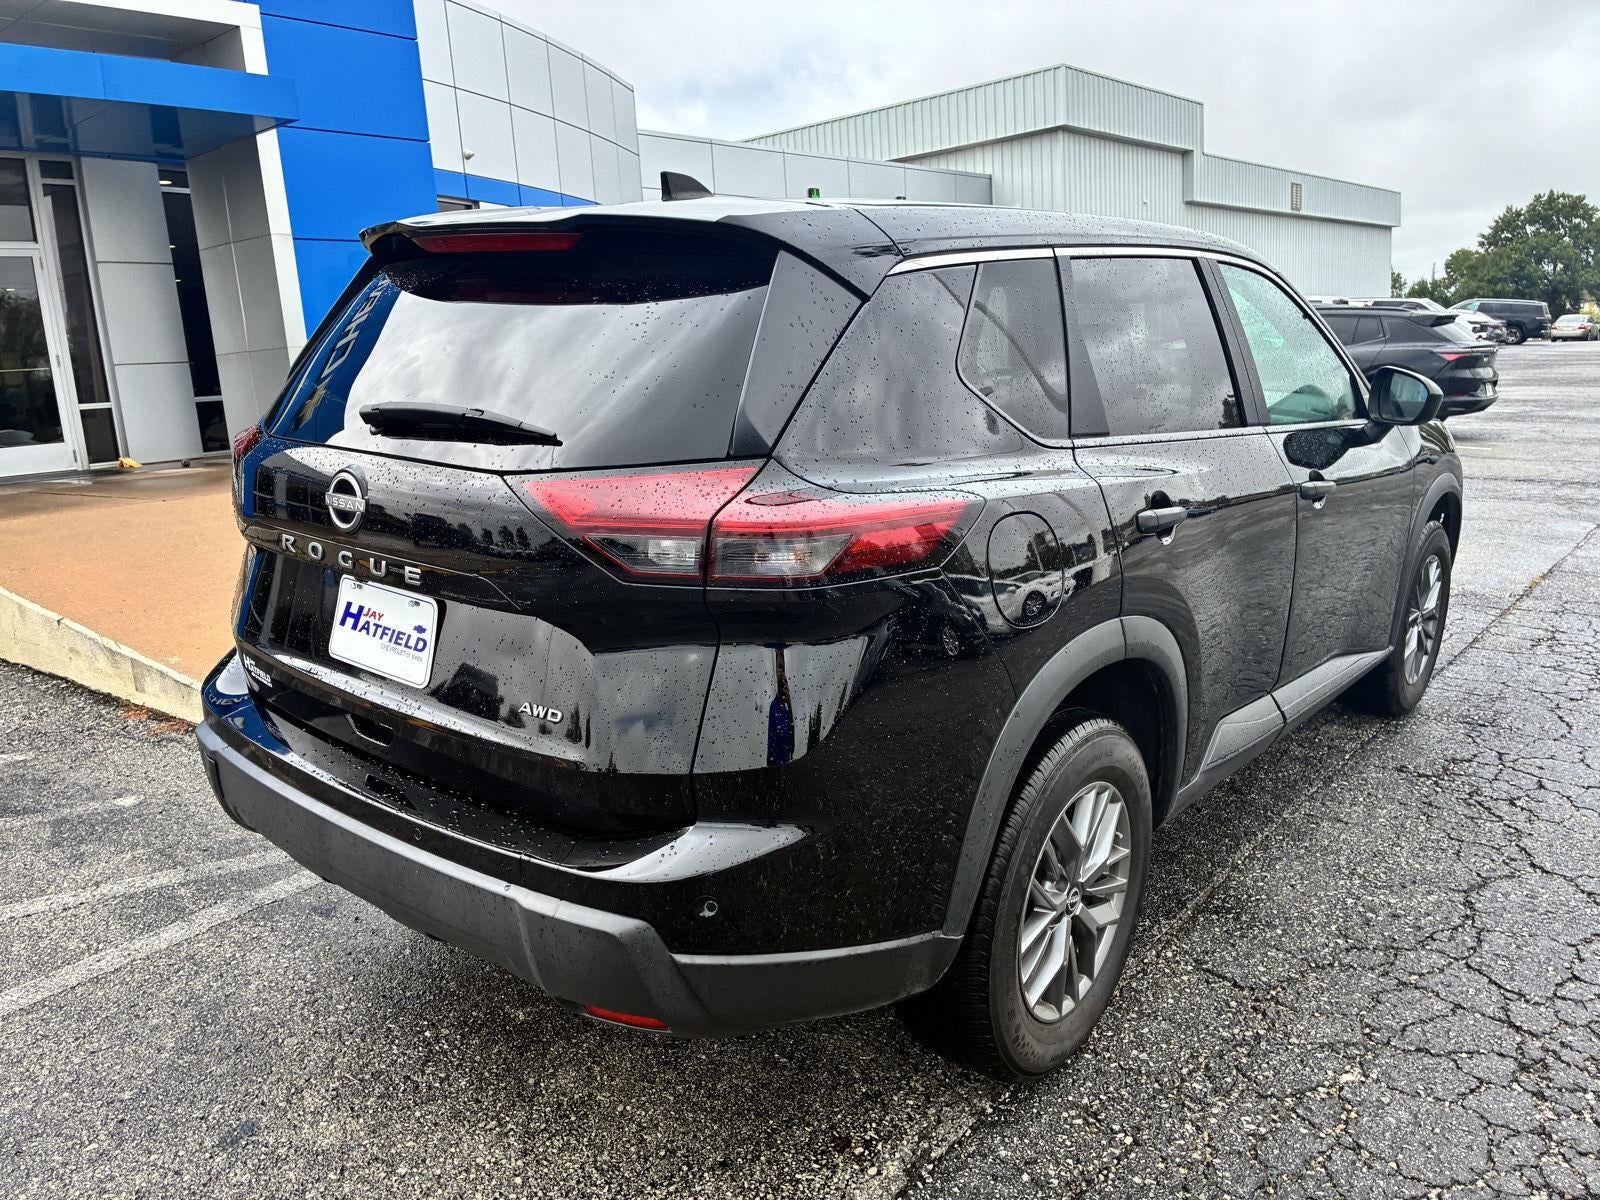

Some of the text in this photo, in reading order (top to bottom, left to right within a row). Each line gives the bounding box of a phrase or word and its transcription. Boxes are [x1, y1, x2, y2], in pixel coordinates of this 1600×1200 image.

[281, 533, 422, 586] ROGUE
[339, 600, 428, 653] HATFIELD
[363, 607, 385, 621] JAY
[518, 702, 563, 722] AWD
